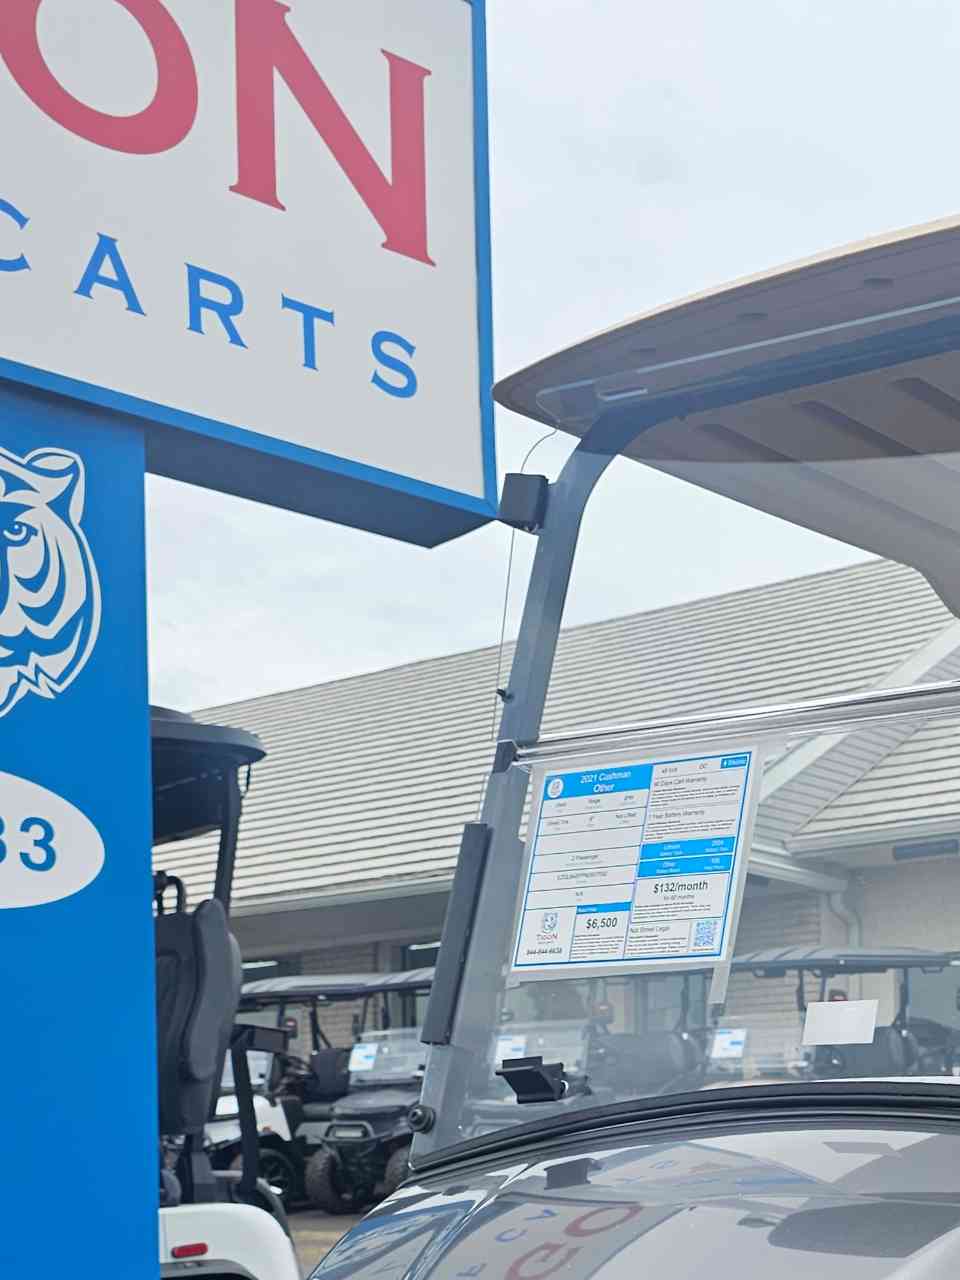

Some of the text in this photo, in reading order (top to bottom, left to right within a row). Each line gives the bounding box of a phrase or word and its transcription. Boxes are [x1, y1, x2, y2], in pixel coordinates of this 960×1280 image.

[0, 0, 436, 267] ON
[0, 815, 57, 872] 3
[653, 880, 709, 894] $132/month
[586, 916, 618, 931] $6,500
